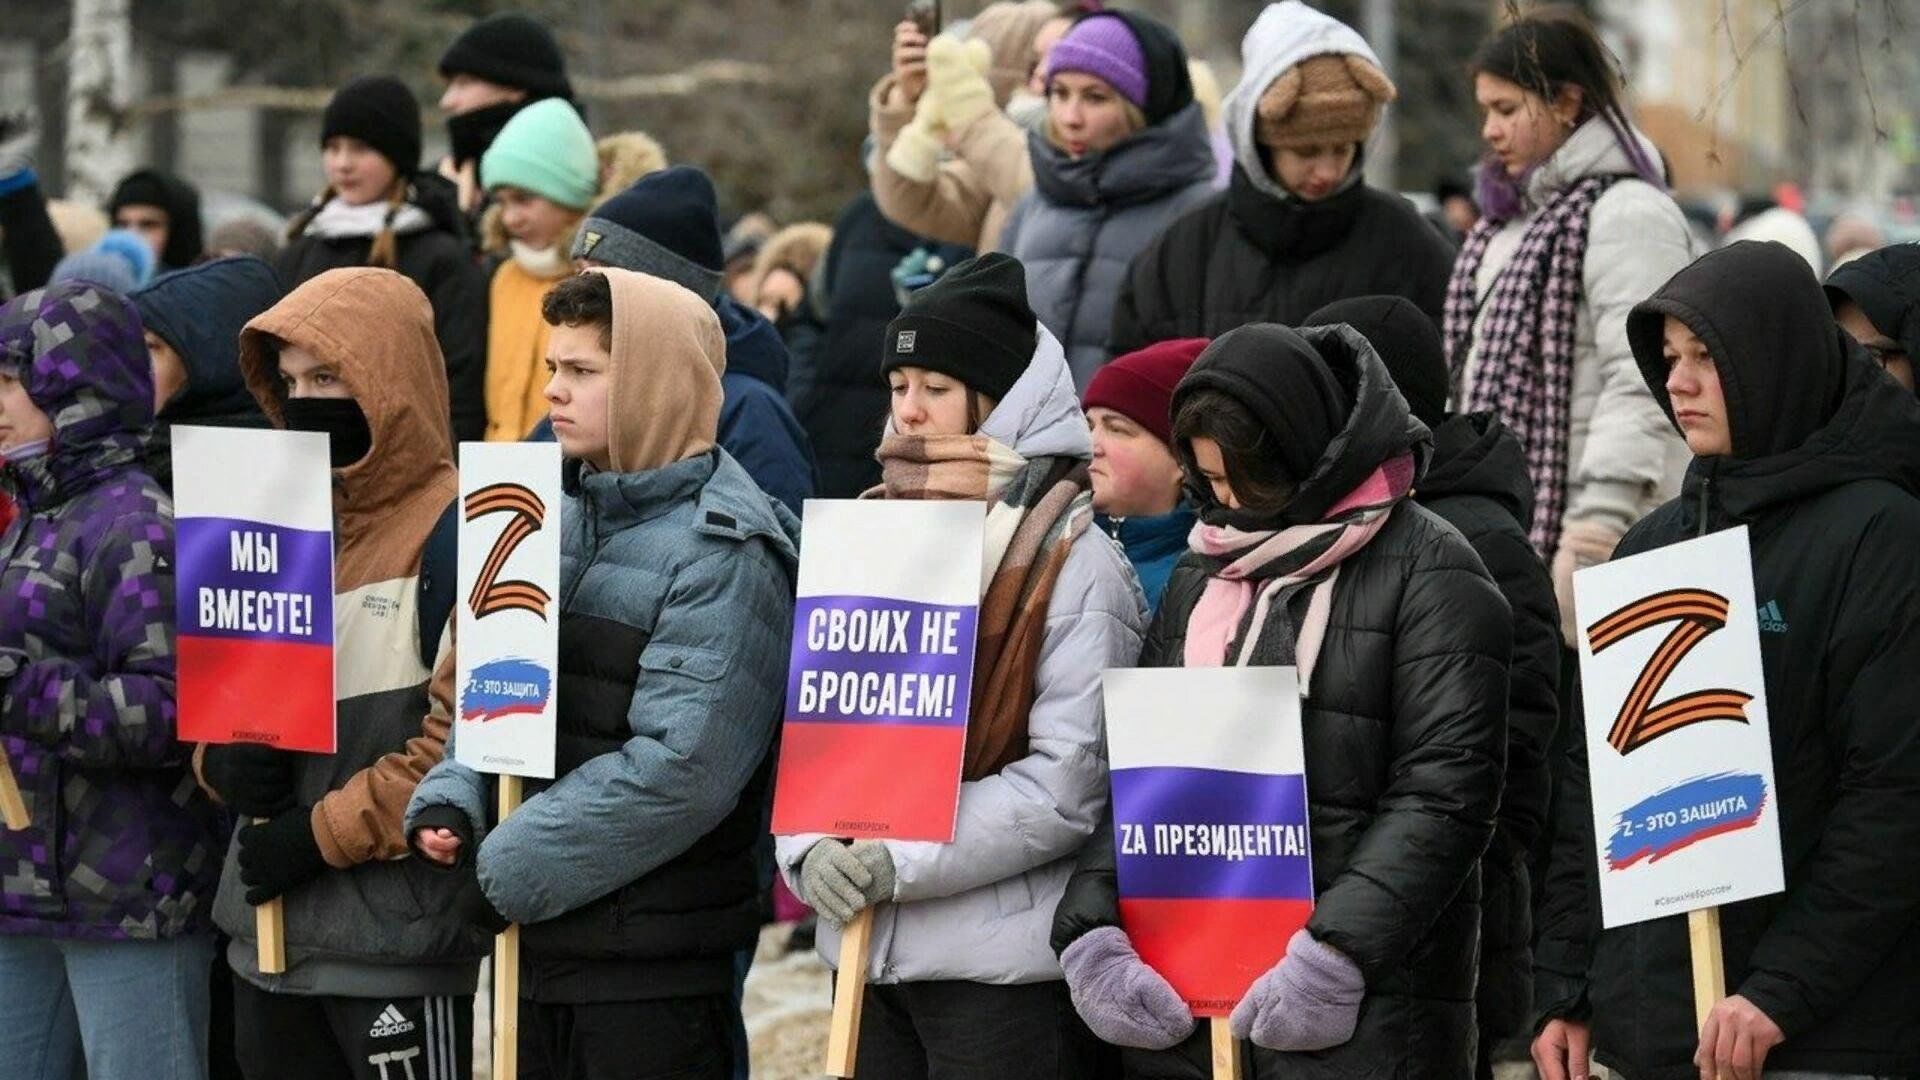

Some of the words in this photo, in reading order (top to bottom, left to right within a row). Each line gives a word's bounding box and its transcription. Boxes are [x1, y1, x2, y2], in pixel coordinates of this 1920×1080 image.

[230, 530, 278, 574] МЫ
[464, 482, 552, 623] Z
[199, 587, 312, 636] ВМЕСТЕ!
[807, 608, 911, 653] СВОИХ
[920, 611, 961, 655] НЕ
[470, 679, 478, 693] Z
[484, 680, 501, 695] ЭТО
[502, 681, 540, 699] ЗАЩИТА
[798, 670, 957, 718] БРОСАЕМ!
[1586, 588, 1755, 757] Z
[1622, 819, 1634, 837] Z
[1646, 811, 1677, 832] ЭТО
[1680, 795, 1748, 825] ЗАЩИТА
[1154, 824, 1306, 861] ПРЕЗИДЕНТА!
[369, 1021, 416, 1037] adidas
